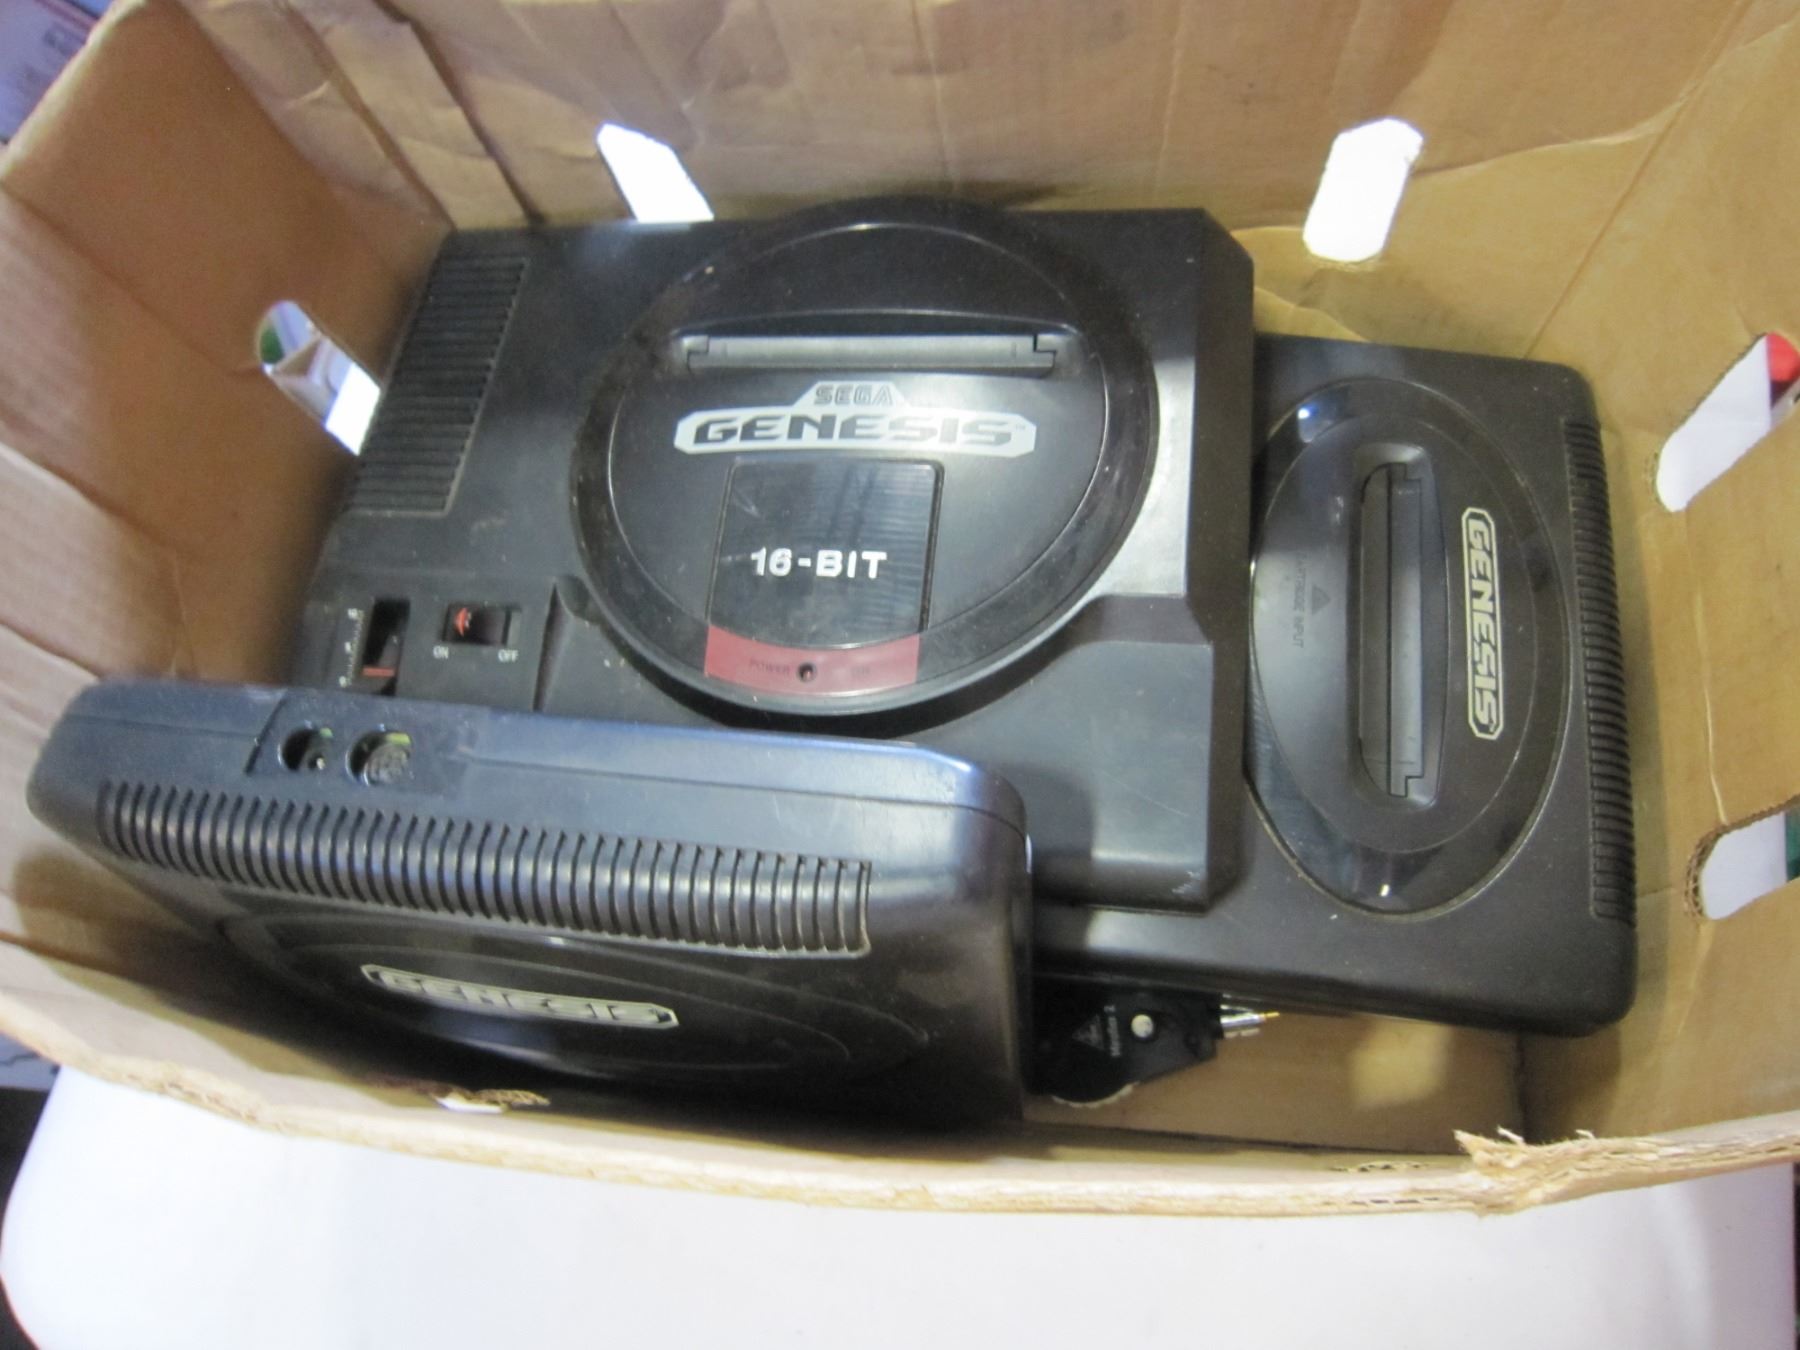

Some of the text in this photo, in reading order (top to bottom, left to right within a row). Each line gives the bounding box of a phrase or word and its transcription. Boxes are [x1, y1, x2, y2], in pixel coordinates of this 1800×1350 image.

[812, 384, 893, 406] SEGA
[692, 413, 1014, 447] GENESIS
[750, 546, 888, 580] 16-BIT
[1467, 517, 1497, 725] GENESIS
[432, 644, 449, 660] ON
[497, 648, 519, 663] OFF
